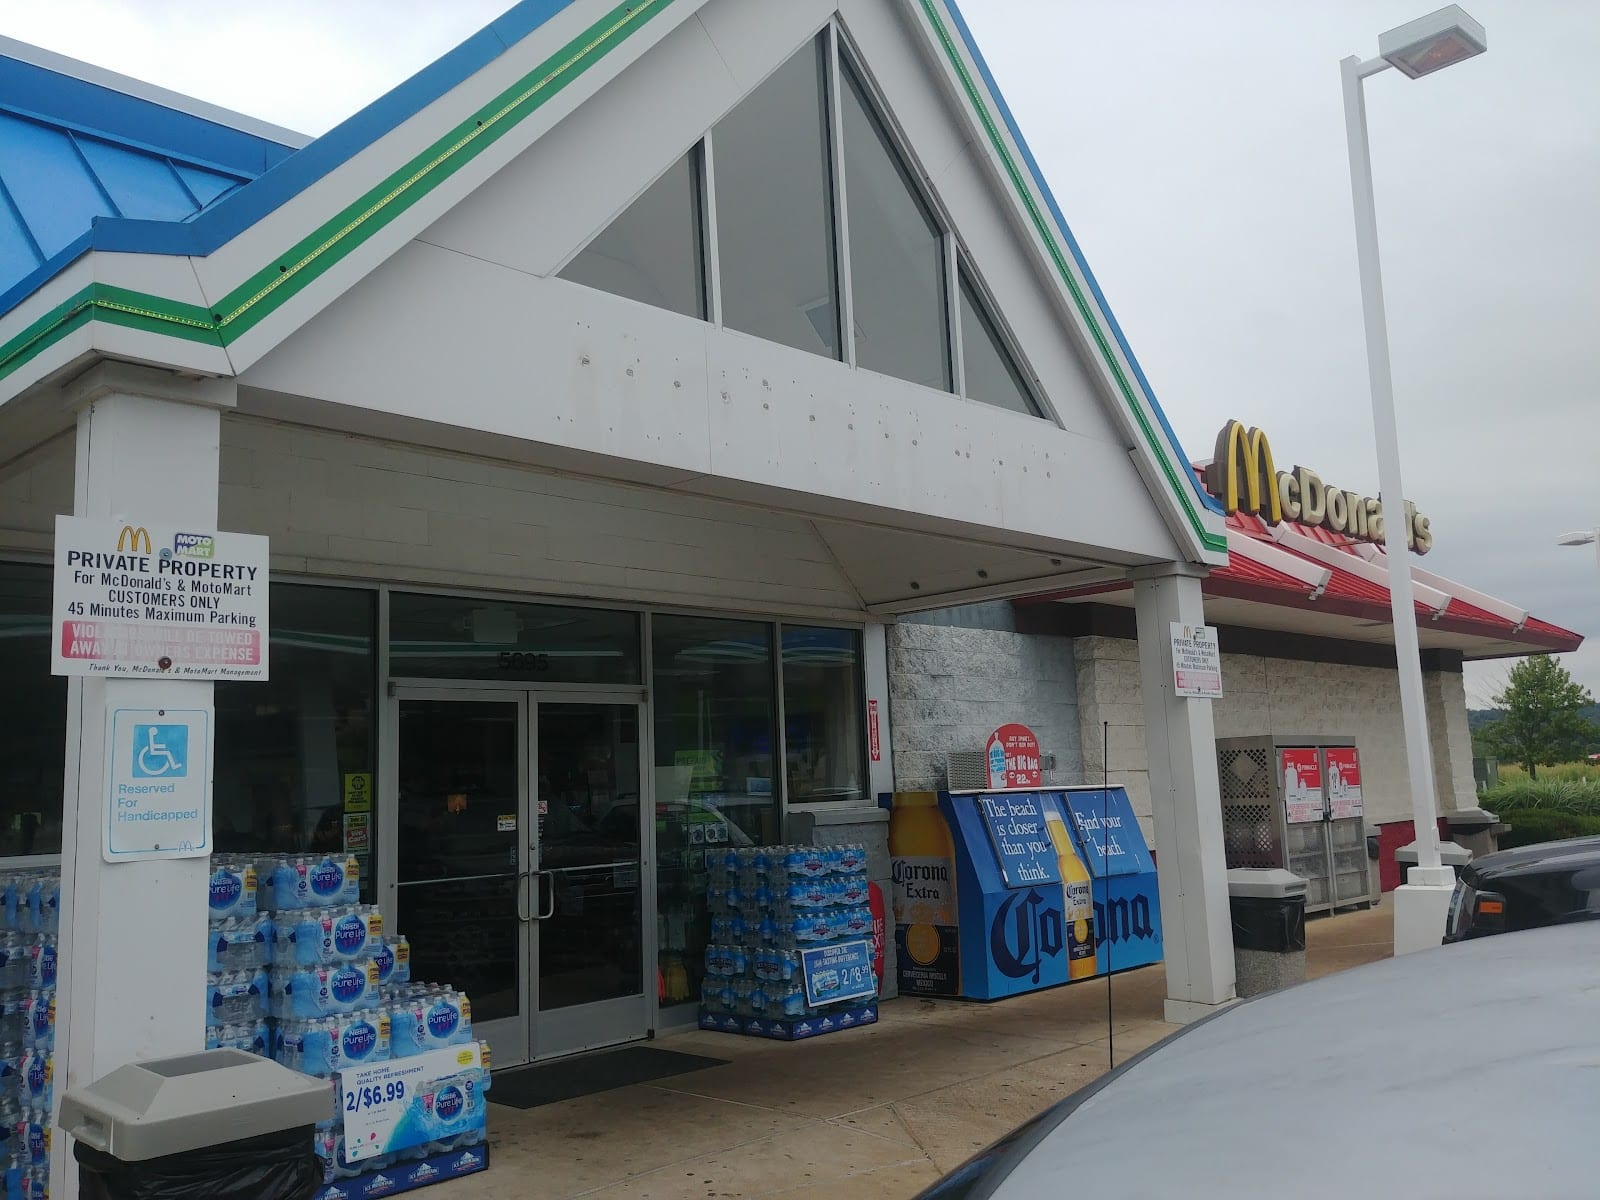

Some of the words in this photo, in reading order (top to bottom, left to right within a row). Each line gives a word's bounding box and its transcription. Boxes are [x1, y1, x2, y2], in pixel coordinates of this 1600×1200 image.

[1222, 419, 1433, 555] McDona's
[176, 534, 212, 546] MOTO
[176, 545, 212, 557] MART
[68, 550, 150, 573] PRIVATE
[159, 559, 257, 581] PROPERTY
[75, 571, 95, 586] For
[102, 573, 172, 592] McDonald's
[178, 580, 187, 592] &
[192, 581, 252, 597] MotoMart
[109, 590, 185, 607] CUSTOMERS
[191, 596, 221, 609] ONLY
[68, 602, 84, 616] 45
[91, 603, 140, 619] Minutes
[146, 608, 205, 623] Maximum
[211, 611, 257, 628] Parking
[209, 631, 253, 646] TOWED
[196, 646, 254, 661] EXPENSE
[89, 663, 110, 672] Thank
[132, 665, 172, 675] McDonals
[220, 668, 262, 677] Management
[1017, 754, 1027, 770] BIG
[118, 783, 175, 794] Reserved
[117, 797, 138, 808] For
[985, 799, 1007, 817] The
[1007, 799, 1037, 817] beach
[117, 809, 199, 822] Handicapped
[1076, 810, 1100, 831] Find
[1100, 815, 1122, 829] your
[995, 819, 1007, 836] is
[1008, 818, 1038, 835] closer
[1002, 835, 1026, 855] than
[1027, 841, 1047, 861] you
[1093, 836, 1125, 857] beach.
[892, 860, 948, 887] Corona
[1018, 861, 1050, 881] think.
[906, 882, 939, 899] Extra
[1067, 884, 1089, 899] Corona
[336, 930, 355, 940] Pure
[355, 929, 365, 941] Life
[991, 888, 1154, 984] Coona
[332, 979, 353, 989] Pure
[429, 1015, 447, 1025] Pure
[446, 1012, 458, 1025] Life
[344, 1035, 364, 1046] Pure
[364, 1032, 376, 1045] Life
[356, 1069, 372, 1079] TAKE
[374, 1066, 391, 1075] HOME
[356, 1075, 382, 1086] QUALITY
[384, 1066, 424, 1080] REFRESHMENT
[346, 1080, 405, 1113] 2/$6.99
[436, 1099, 451, 1109] Pure
[451, 1096, 463, 1108] Life
